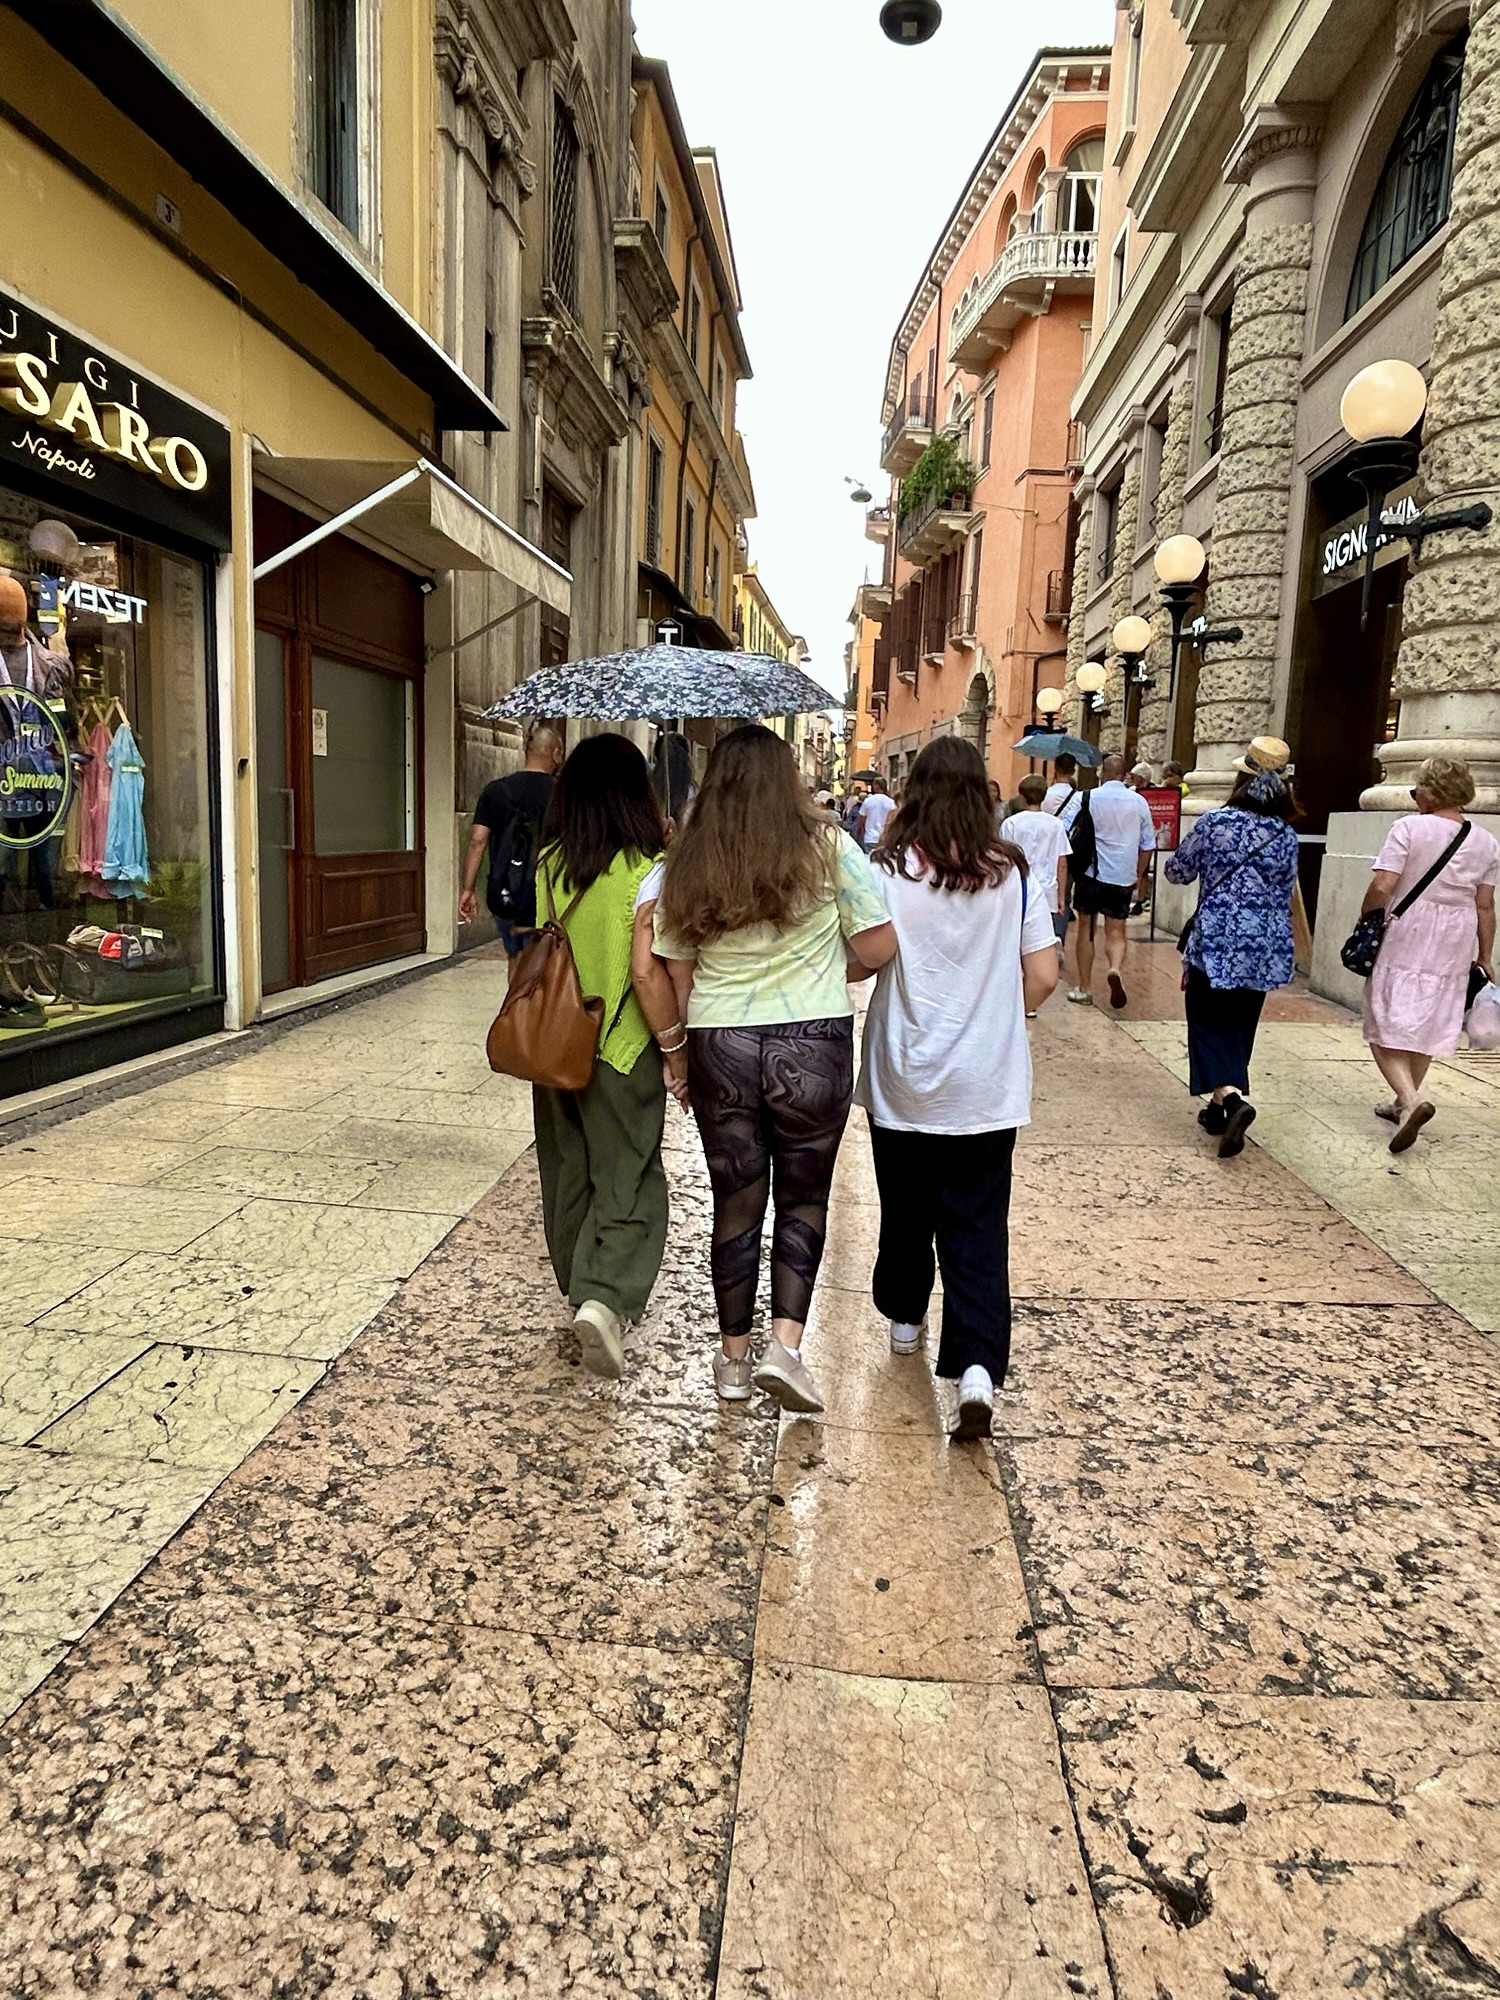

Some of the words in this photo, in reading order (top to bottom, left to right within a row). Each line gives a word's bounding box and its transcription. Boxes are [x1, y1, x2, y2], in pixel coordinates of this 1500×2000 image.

[0, 309, 140, 410] UIGI
[14, 351, 208, 491] SARO
[11, 430, 96, 480] Napoli
[658, 627, 679, 646] T
[0, 765, 63, 797] Summer
[0, 800, 56, 812] ITION
